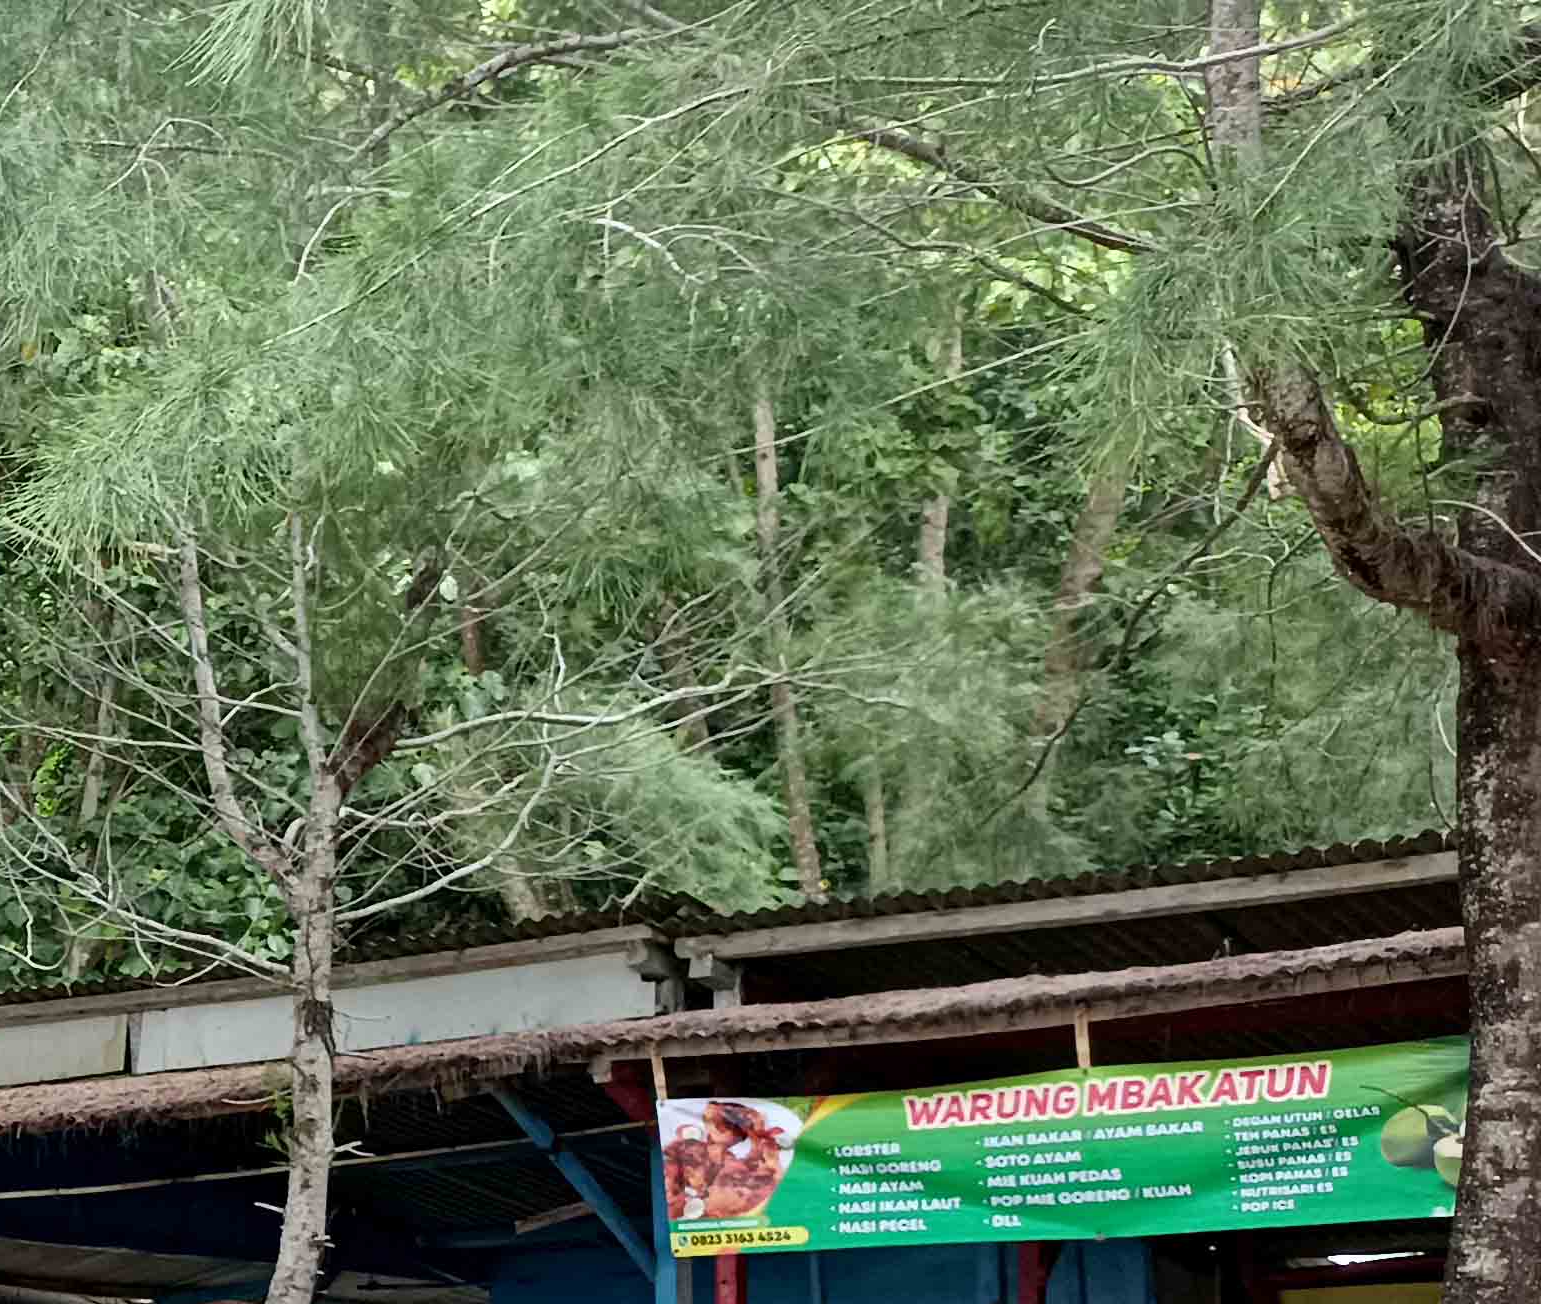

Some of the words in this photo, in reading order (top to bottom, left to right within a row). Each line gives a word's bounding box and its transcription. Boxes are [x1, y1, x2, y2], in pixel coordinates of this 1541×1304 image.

[907, 1085, 1077, 1126] WARUNG
[1085, 1072, 1207, 1113] MBAK
[1210, 1064, 1328, 1104] ATUN
[984, 1134, 1025, 1148] IKAN
[1027, 1130, 1082, 1145] BAKAR
[1092, 1126, 1144, 1141] AYAM
[1146, 1121, 1204, 1136] BAKAR
[1263, 1125, 1310, 1140] PANAS
[1320, 1123, 1337, 1135] ES
[834, 1142, 901, 1157] LOBSTER
[1282, 1138, 1333, 1153] PANAS
[1341, 1135, 1359, 1148] ES
[839, 1164, 875, 1177] NASI
[876, 1159, 942, 1174] GORENG
[985, 1154, 1031, 1169] SOTO
[1033, 1150, 1081, 1165] AYAM
[1237, 1156, 1275, 1169] SUSU
[1278, 1152, 1326, 1167] PANAS
[1335, 1150, 1352, 1162] ES
[987, 1175, 1017, 1188] MIE
[1068, 1168, 1122, 1184] PEDAS
[1239, 1172, 1275, 1185] KOPI
[1275, 1168, 1324, 1182] PANAS
[1332, 1166, 1349, 1178] ES
[839, 1182, 877, 1195] NASI
[878, 1180, 925, 1193] AYAM
[1316, 1181, 1334, 1194] ES
[839, 1201, 877, 1214] NASI
[878, 1199, 920, 1213] IKAN
[921, 1196, 962, 1211] LAUT
[991, 1194, 1024, 1208] POP
[1025, 1192, 1057, 1206] MIE
[1059, 1187, 1131, 1205] GORENG
[1241, 1201, 1270, 1214] POP
[839, 1220, 877, 1234] NASI
[879, 1218, 928, 1233] PECEL
[992, 1214, 1022, 1228] DLL
[691, 1234, 722, 1247] 0823
[724, 1233, 754, 1245] 3163
